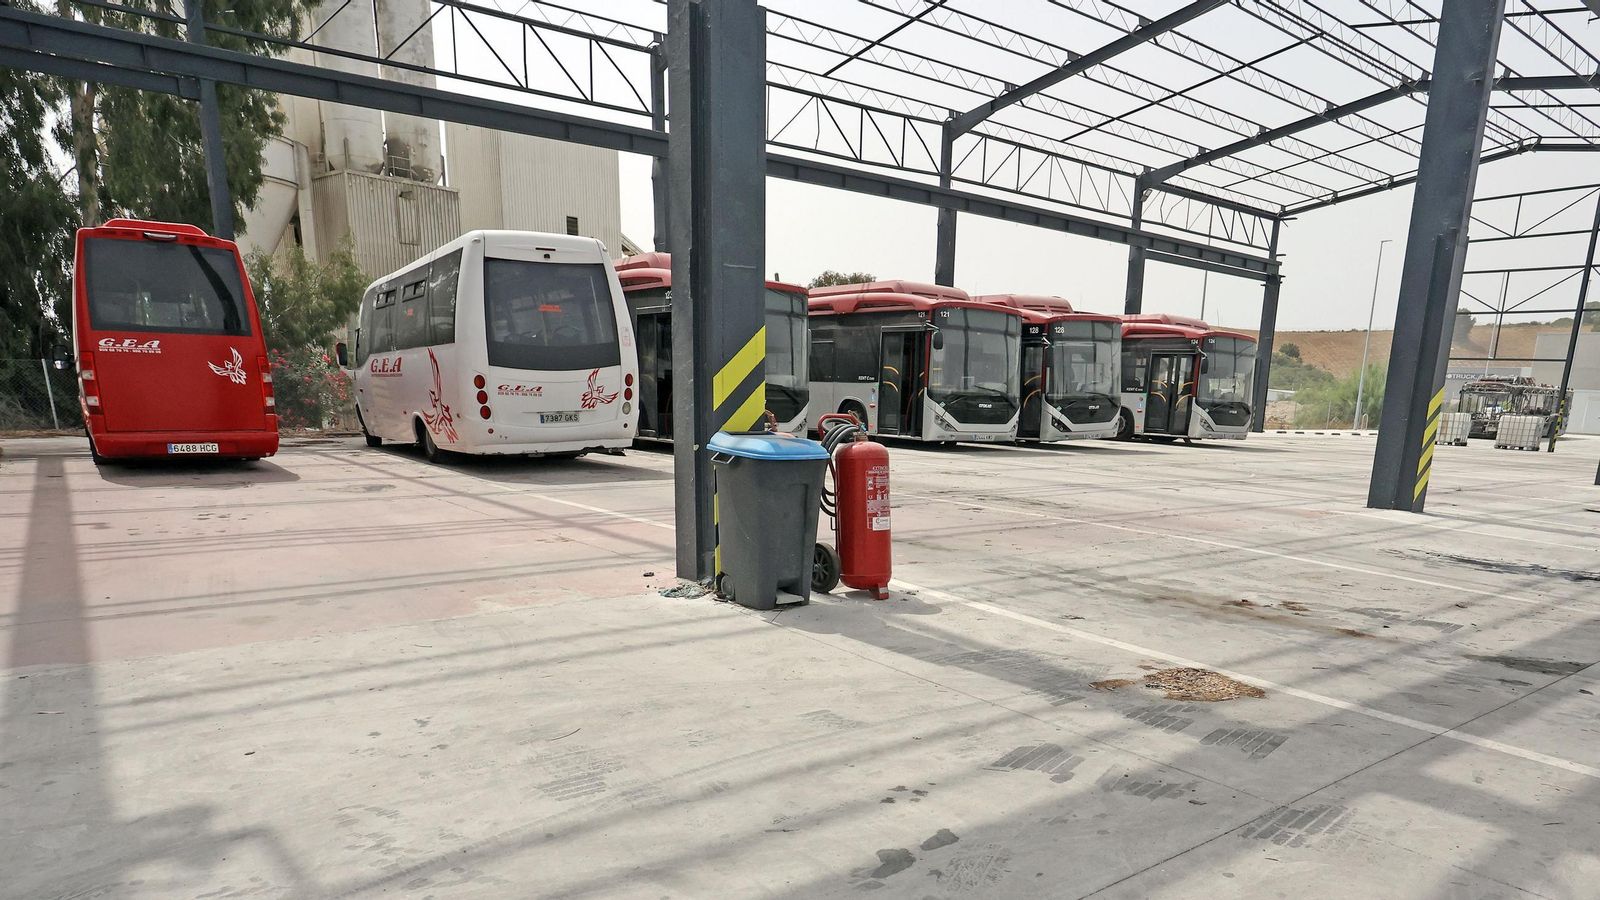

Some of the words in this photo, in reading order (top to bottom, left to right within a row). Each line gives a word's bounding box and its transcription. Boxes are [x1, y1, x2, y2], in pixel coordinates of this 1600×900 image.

[1029, 326, 1039, 334] 128
[1054, 326, 1065, 334] 128
[98, 337, 160, 348] G.E.A
[370, 356, 402, 373] G.E.A
[545, 414, 563, 422] 7387
[564, 414, 579, 422] GKS
[173, 444, 198, 452] 6488
[199, 444, 217, 452] HCG
